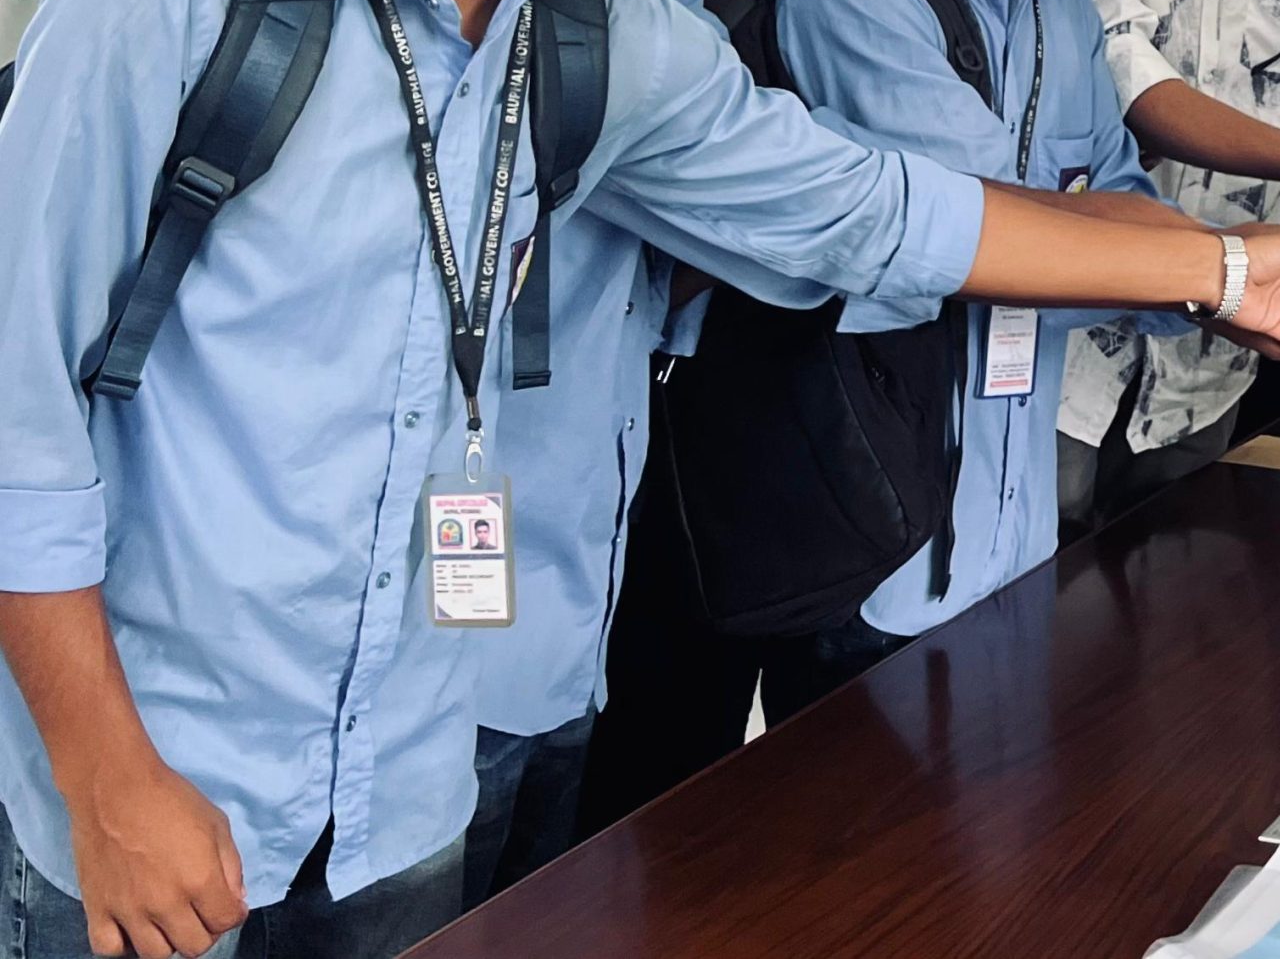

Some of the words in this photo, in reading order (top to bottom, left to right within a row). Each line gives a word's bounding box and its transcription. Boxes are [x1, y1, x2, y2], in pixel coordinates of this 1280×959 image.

[405, 66, 426, 125] BAUPHAL
[504, 67, 526, 124] BAUPHAL
[421, 142, 439, 190] COEGE
[428, 192, 457, 276] GOVERNMENT
[482, 189, 505, 276] GOVERNMENT
[449, 275, 467, 336] BHAL
